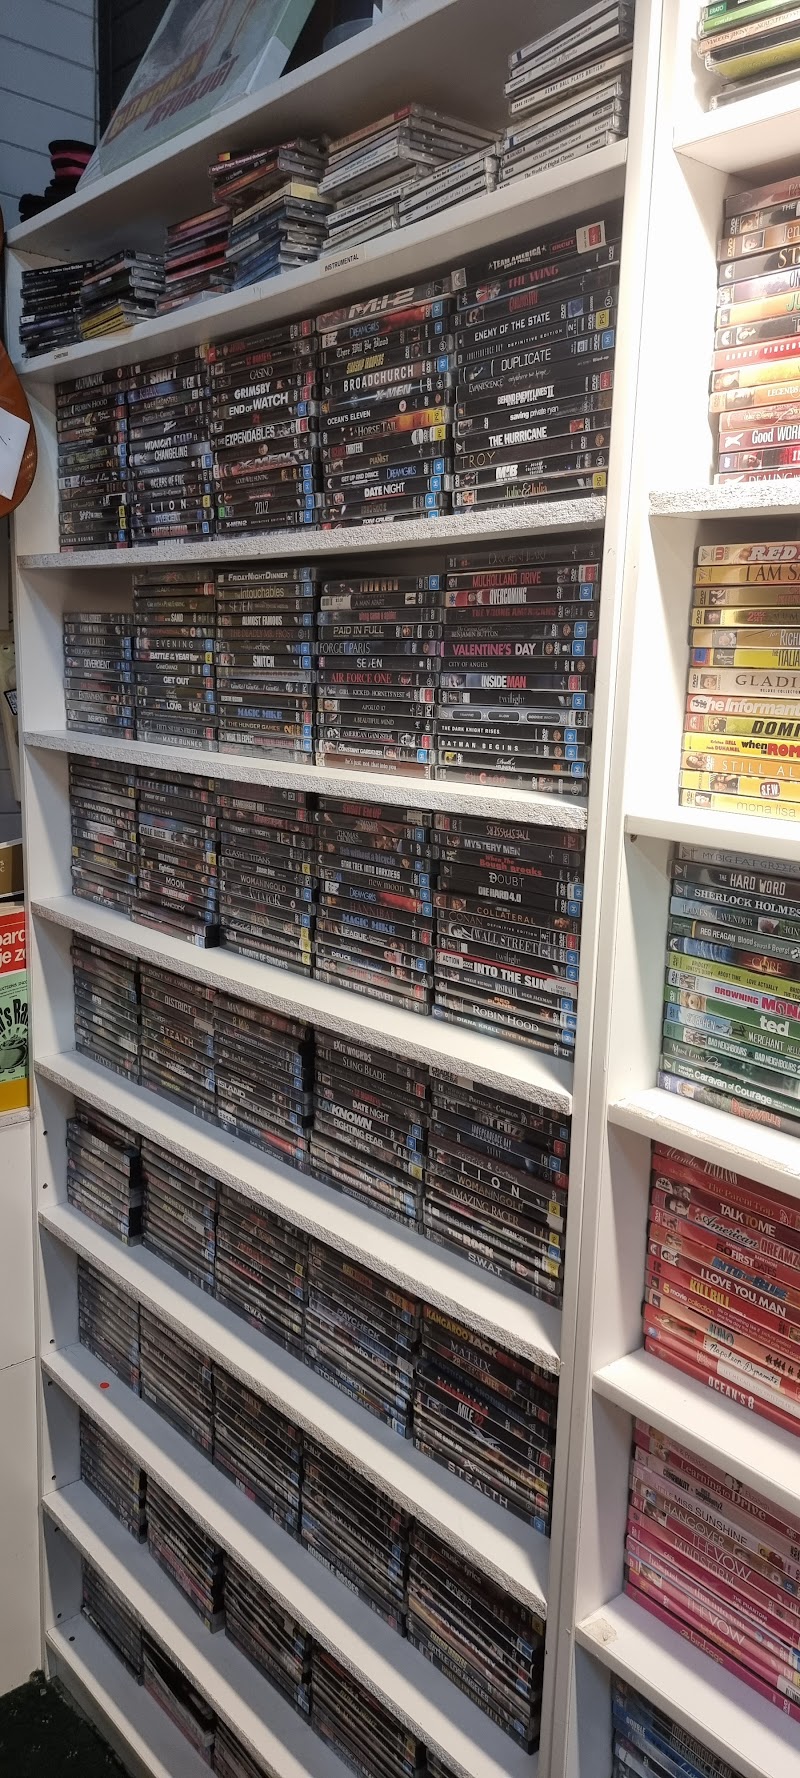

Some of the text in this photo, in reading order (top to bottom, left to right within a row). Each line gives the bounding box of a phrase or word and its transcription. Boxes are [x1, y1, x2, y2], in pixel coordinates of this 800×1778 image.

[782, 202, 796, 211] THE
[325, 254, 359, 272] INSTRUMENTAL
[493, 247, 541, 270] TEAM AMERICA
[475, 312, 550, 341] ENEMY OF THE STATE
[501, 348, 551, 371] DUPLICATE
[150, 367, 177, 384] SHAFT
[250, 366, 273, 380] CASINO
[344, 365, 414, 392] BROADCHURCH
[234, 382, 271, 399] GRIMSBY
[229, 405, 245, 416] END
[253, 392, 288, 410] WATCH
[510, 405, 559, 420] saving private ryan
[327, 410, 370, 425] OCEAN'S ELEVEN
[225, 426, 275, 446] EXPENDABLES
[489, 426, 547, 447] THE HURRICANE
[752, 429, 774, 444] Good
[460, 451, 496, 468] TROY
[364, 482, 405, 498] DATE NIGHT
[255, 501, 269, 514] 2012
[472, 571, 541, 587] MULHOLLAND DRIVE
[490, 587, 527, 604] OVERCOMING
[242, 616, 282, 625] ALMOST FAMOUS
[333, 626, 352, 634] PAID
[156, 639, 193, 648] EVENING
[320, 642, 370, 654] FORGET PARIS
[453, 643, 536, 655] VALENTINE'S DAY
[150, 652, 169, 660] BATTLE
[163, 676, 189, 685] GET OUT
[331, 673, 392, 684] AIR FORCE ONE
[238, 708, 282, 719] MAGIC MIKE
[162, 736, 202, 748] MAZE RUNNER
[442, 740, 519, 752] BATMAN BEGINS
[741, 740, 768, 749] when
[722, 760, 765, 774] STILL
[737, 801, 796, 817] mona lisa
[464, 839, 521, 856] MYSTERY MEN
[703, 851, 756, 866] MY BIG FAT
[353, 862, 363, 870] TREK
[364, 864, 375, 874] INTO
[376, 867, 400, 879] DARKNESS
[480, 859, 543, 877] Bough Breaks
[166, 877, 185, 889] MOON
[369, 879, 404, 892] new moon
[489, 872, 525, 887] DOUBT
[730, 873, 756, 890] HARD
[760, 879, 786, 896] WORD
[478, 886, 522, 903] DIE HARD 4.0
[694, 889, 800, 918] SHERLOCK HOLMES
[342, 914, 395, 935] MAGIC MIKE
[448, 912, 483, 926] CONAN
[477, 907, 536, 925] COLLATERAL
[473, 928, 539, 954] WALL STREET
[700, 927, 753, 946] REG REAGAN Blood
[442, 956, 459, 965] ACTION
[474, 962, 548, 992] INTO THE SUN
[339, 978, 393, 1002] YOU GOT SERVED
[714, 986, 759, 1005] DROWNING
[758, 981, 778, 992] ACTUALLY
[472, 1005, 539, 1032] ROBIN HOOD
[760, 1015, 789, 1036] ted
[707, 1037, 748, 1056] BAD NEIGHBOURS
[748, 1031, 784, 1051] MERCHANT
[343, 1056, 386, 1081] SLING BLADE
[754, 1052, 797, 1073] BAD NEIGHBOURS
[694, 1070, 728, 1089] Caravan
[734, 1084, 772, 1105] Courage
[450, 1188, 519, 1226] AMAZING RACER
[719, 1203, 776, 1237] TALK TO ME
[699, 1212, 758, 1248] American
[663, 1282, 714, 1315] 5 movie collection
[690, 1278, 730, 1308] KILL BILL
[701, 1268, 787, 1318] I LOVE YOU, MAN
[427, 1308, 498, 1359] KANGAROO JACK
[708, 1376, 755, 1410] OCEAN'S 8
[448, 1462, 508, 1508] STEALTH
[680, 1460, 722, 1494] Learning
[722, 1488, 731, 1499] to
[731, 1490, 767, 1521] Drive
[663, 1500, 725, 1546] HANGOVER
[674, 1495, 693, 1512] MISS
[695, 1507, 749, 1544] SUNSHINE
[693, 1533, 752, 1581] THE VOW
[687, 1597, 746, 1645] THE VOW
